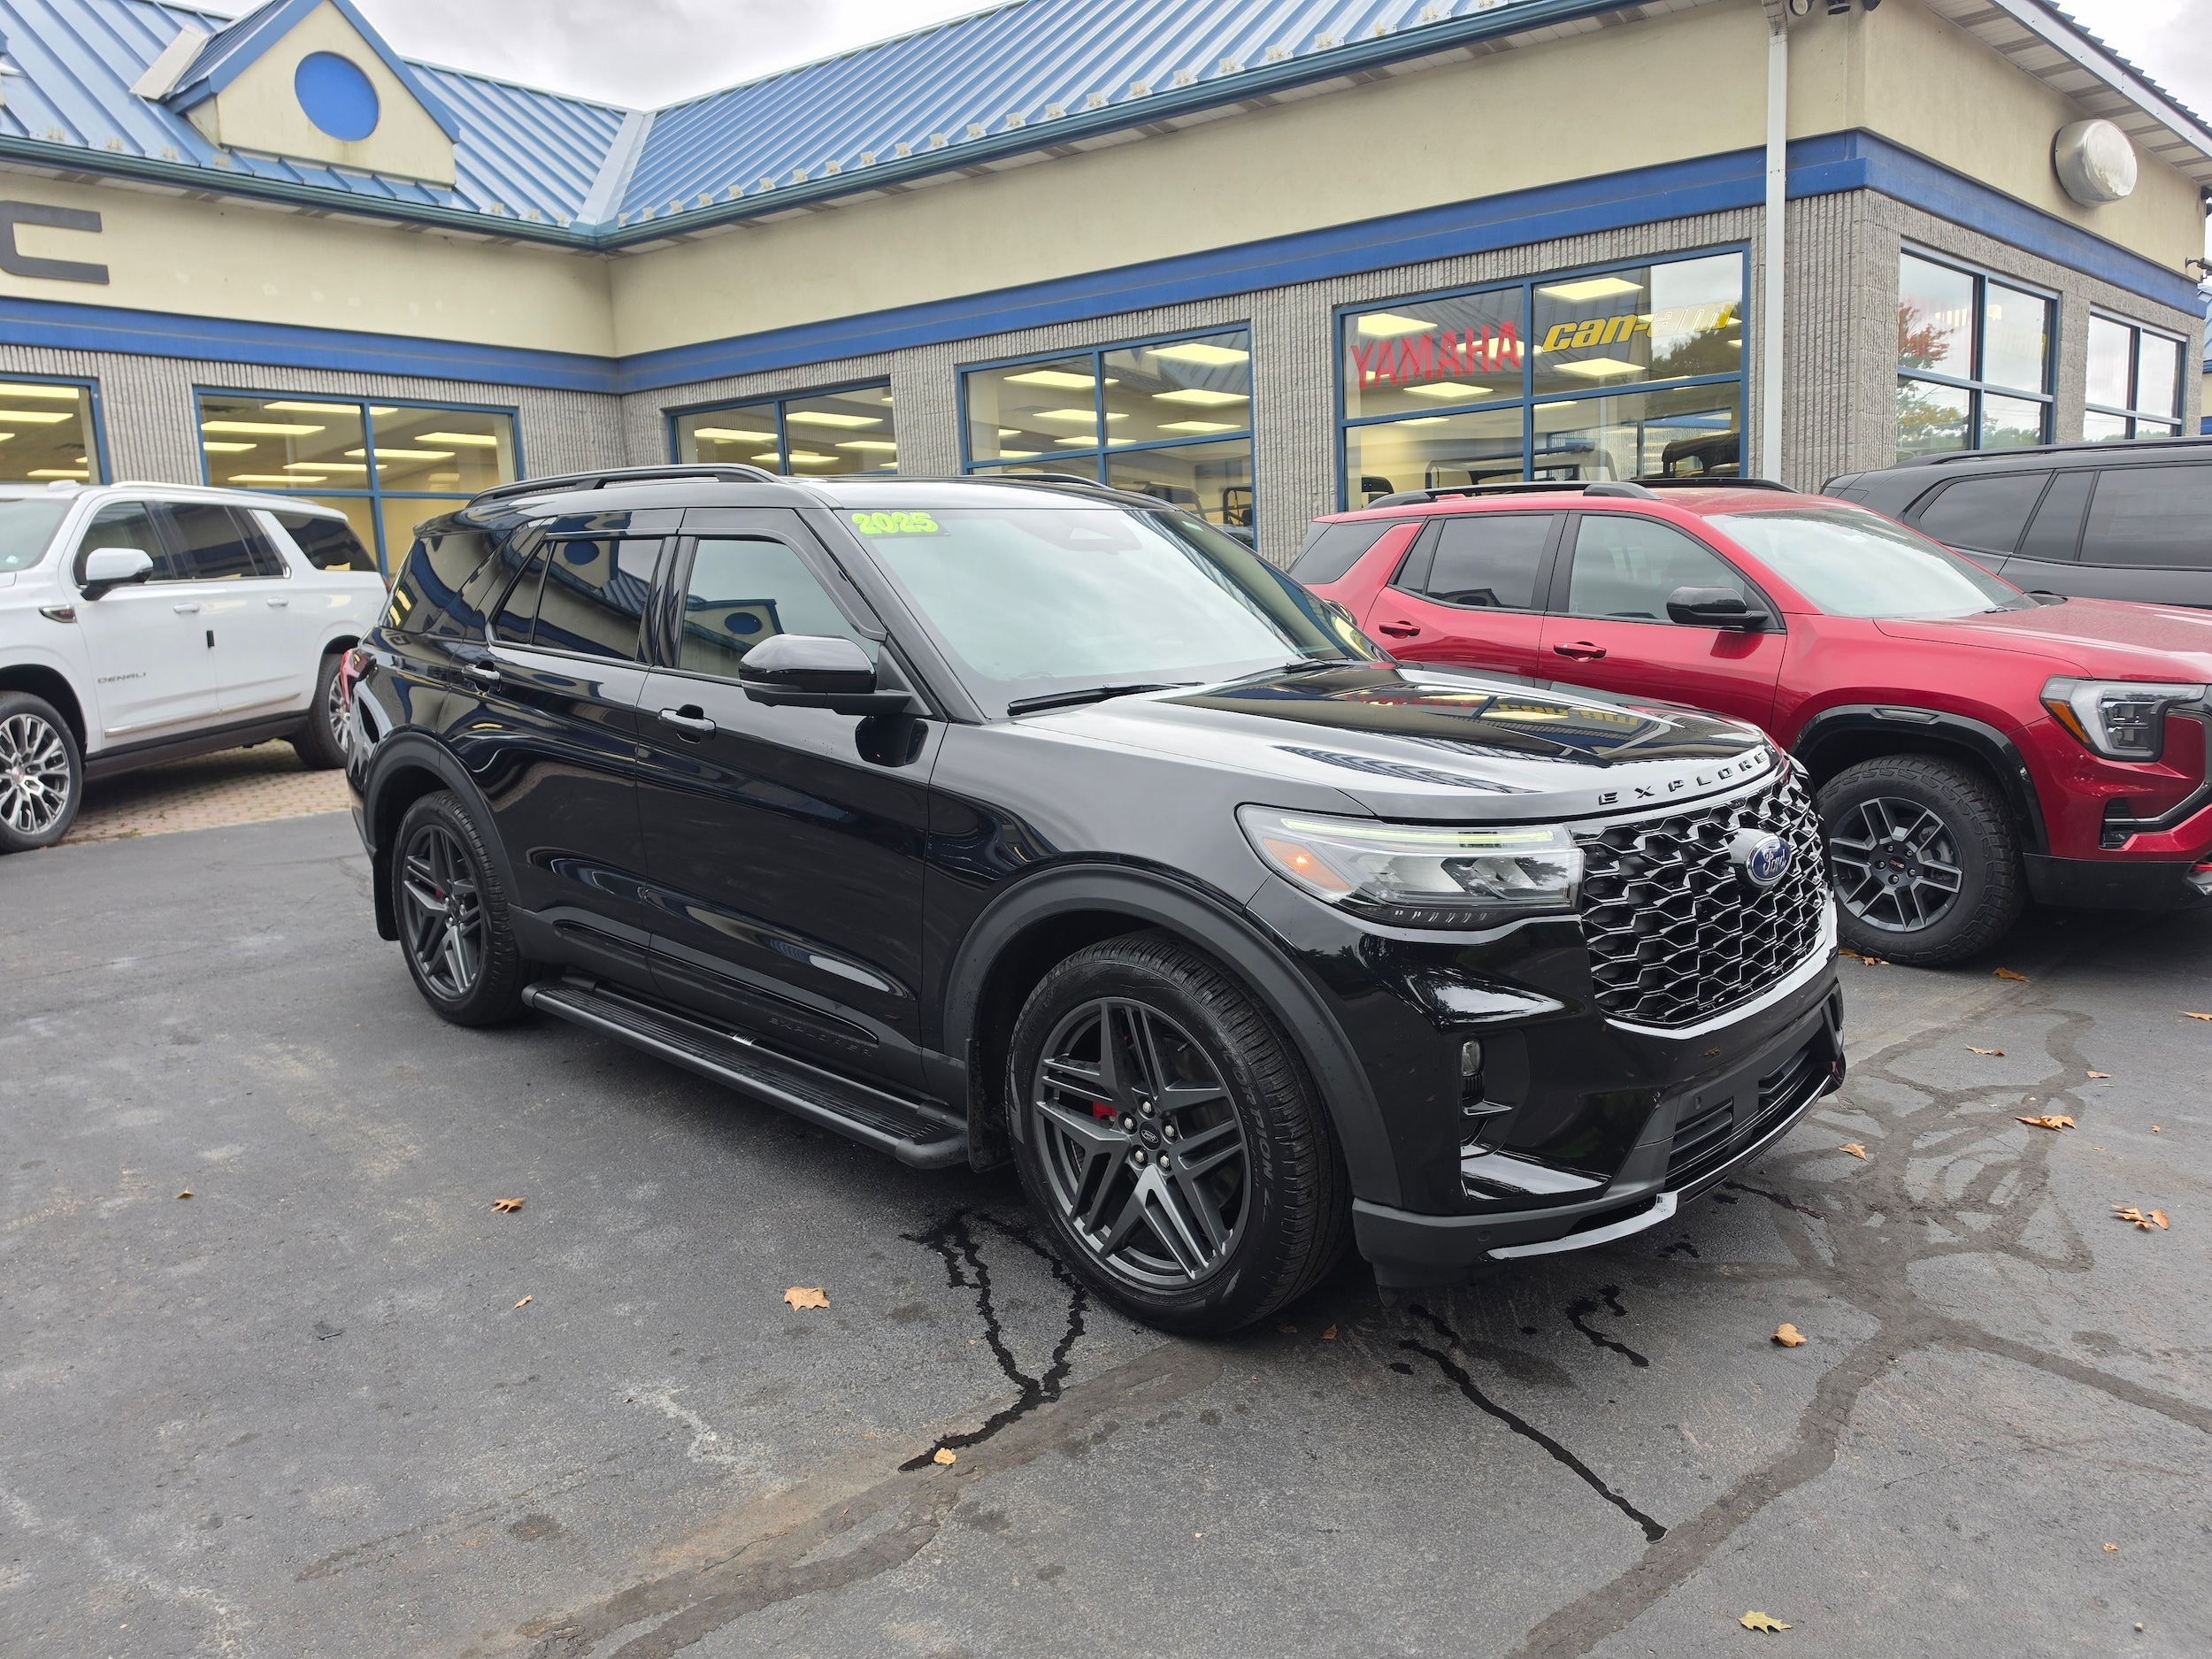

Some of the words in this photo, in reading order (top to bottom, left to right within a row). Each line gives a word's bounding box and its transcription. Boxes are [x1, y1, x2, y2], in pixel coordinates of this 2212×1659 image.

[1542, 299, 1737, 353] can-am
[1350, 320, 1521, 390] YAMAHA
[851, 511, 939, 534] 2025
[97, 672, 147, 684] DENALI
[1598, 745, 1777, 806] EXPLORER
[1762, 845, 1788, 876] Ford
[768, 1017, 873, 1057] EXPLORER
